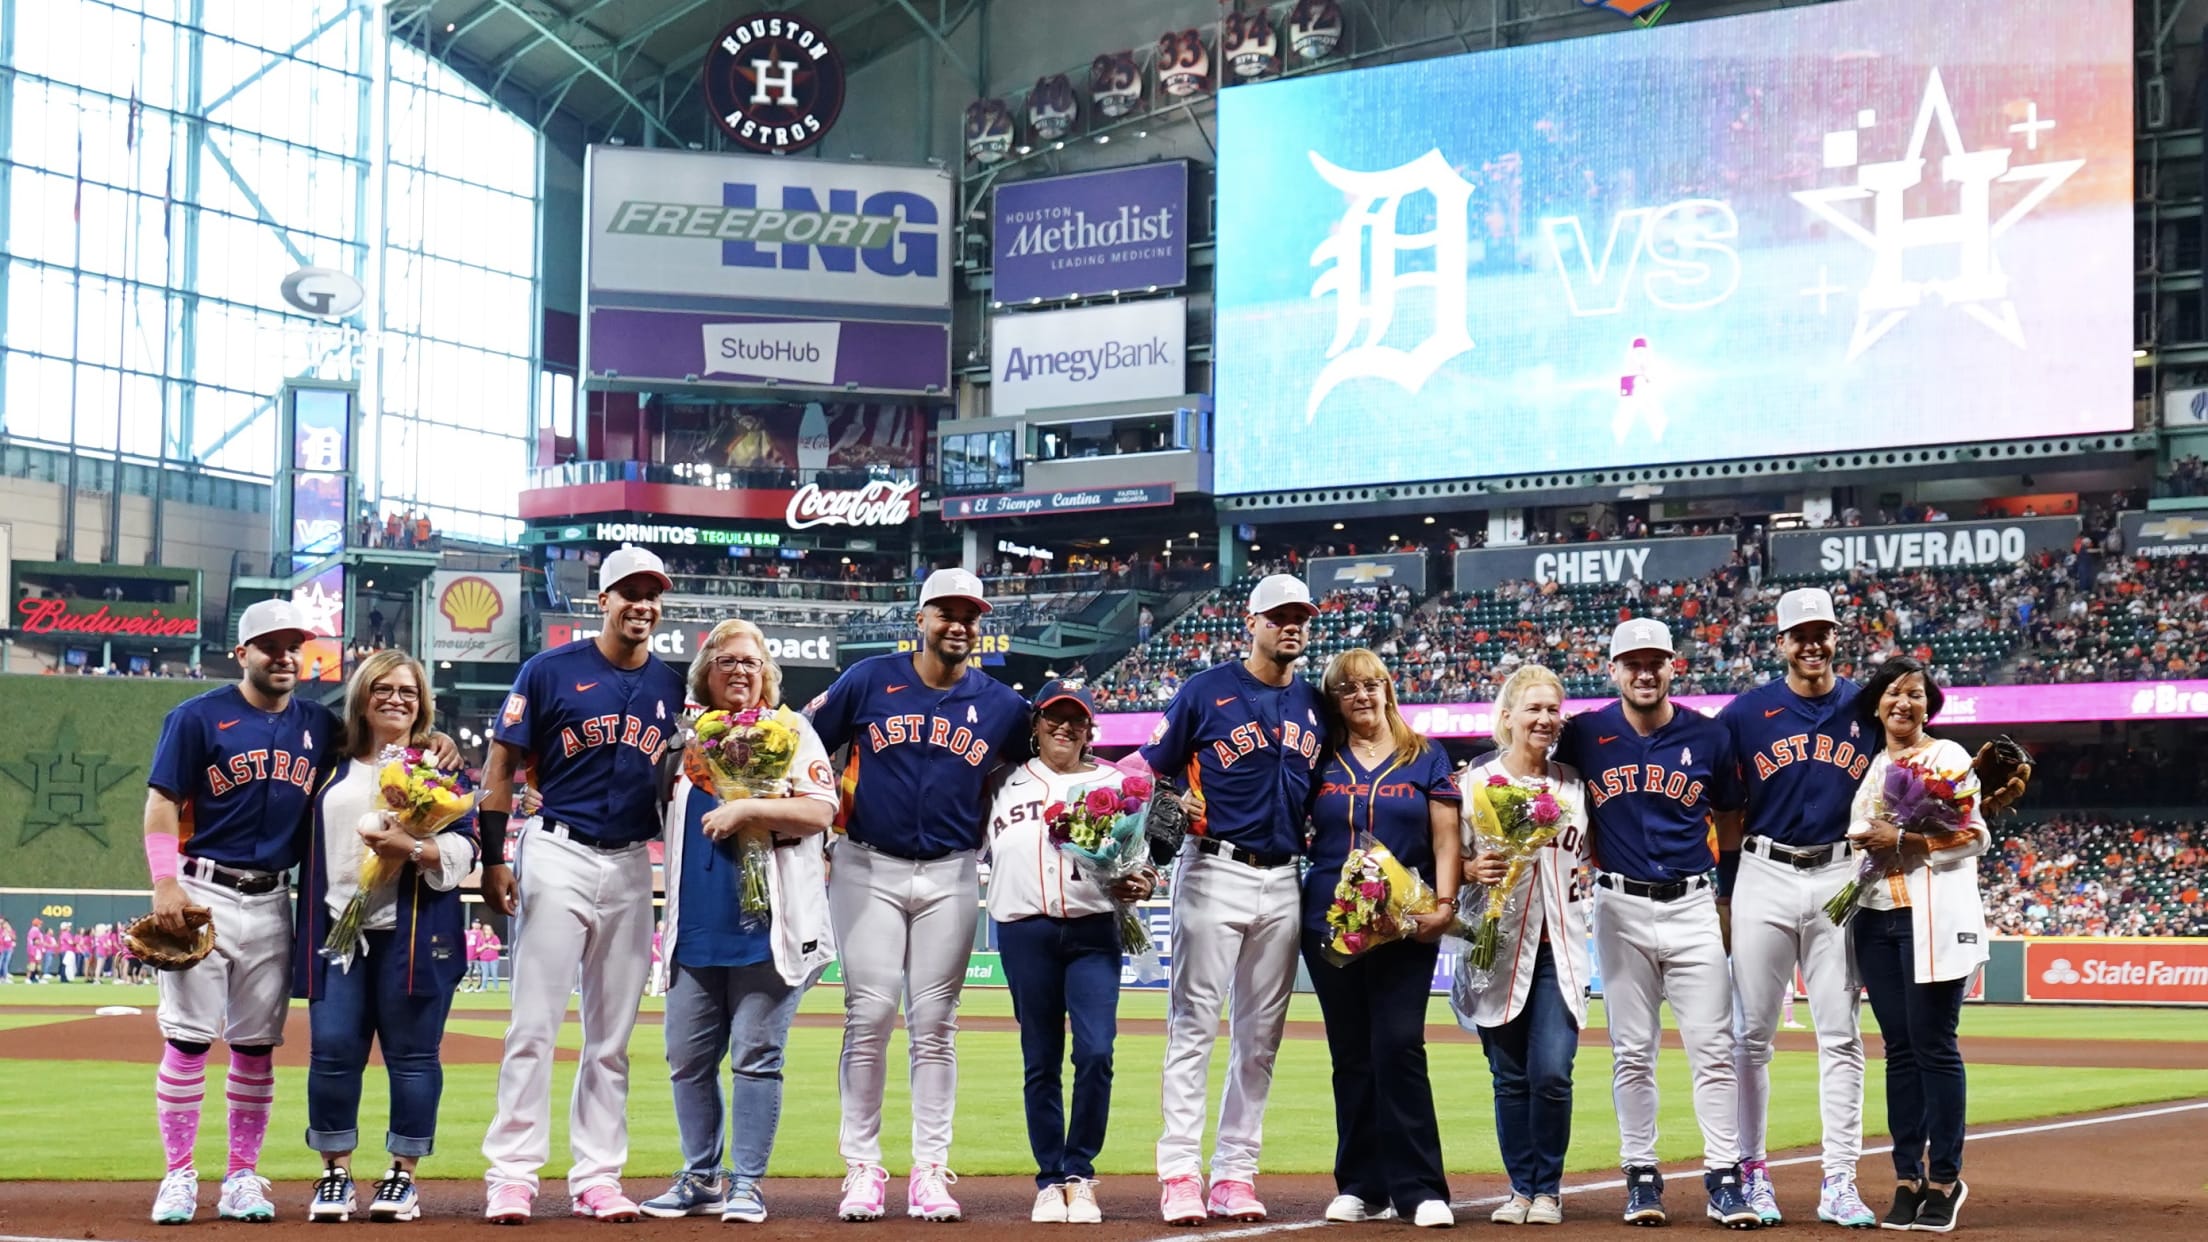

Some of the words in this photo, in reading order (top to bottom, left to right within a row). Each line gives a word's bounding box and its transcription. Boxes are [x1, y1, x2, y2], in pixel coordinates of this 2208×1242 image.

[722, 18, 829, 60] HOUSTON
[1158, 28, 1200, 70] 33
[750, 59, 799, 106] H
[725, 110, 820, 146] ASTROS
[617, 202, 893, 246] FREEPORT
[722, 182, 938, 278] LNG
[1005, 205, 1174, 258] Methodist
[1006, 206, 1072, 224] HOUSTON
[1052, 255, 1105, 270] LEADING
[1111, 246, 1173, 263] MEDICINE
[1543, 195, 1741, 316] VS
[720, 337, 820, 363] StubHub
[785, 479, 918, 529] Coca-Cola
[974, 498, 989, 513] El
[997, 496, 1043, 513] Tiempo
[1052, 492, 1101, 508] Cantina
[596, 522, 697, 545] HORNITOS
[702, 530, 752, 545] TEQUILA
[754, 532, 780, 546] BAR
[1820, 526, 2026, 571] SILVERADO
[1534, 547, 1650, 585] CHEVY
[18, 597, 200, 636] Budweiser
[868, 712, 990, 767] ASTROS
[1212, 720, 1323, 770] ASTROS
[1753, 733, 1870, 781] ASTROS
[207, 748, 317, 797] ASTROS
[1377, 783, 1416, 799] CITY
[1587, 763, 1703, 808] ASTROS
[42, 904, 73, 918] 409
